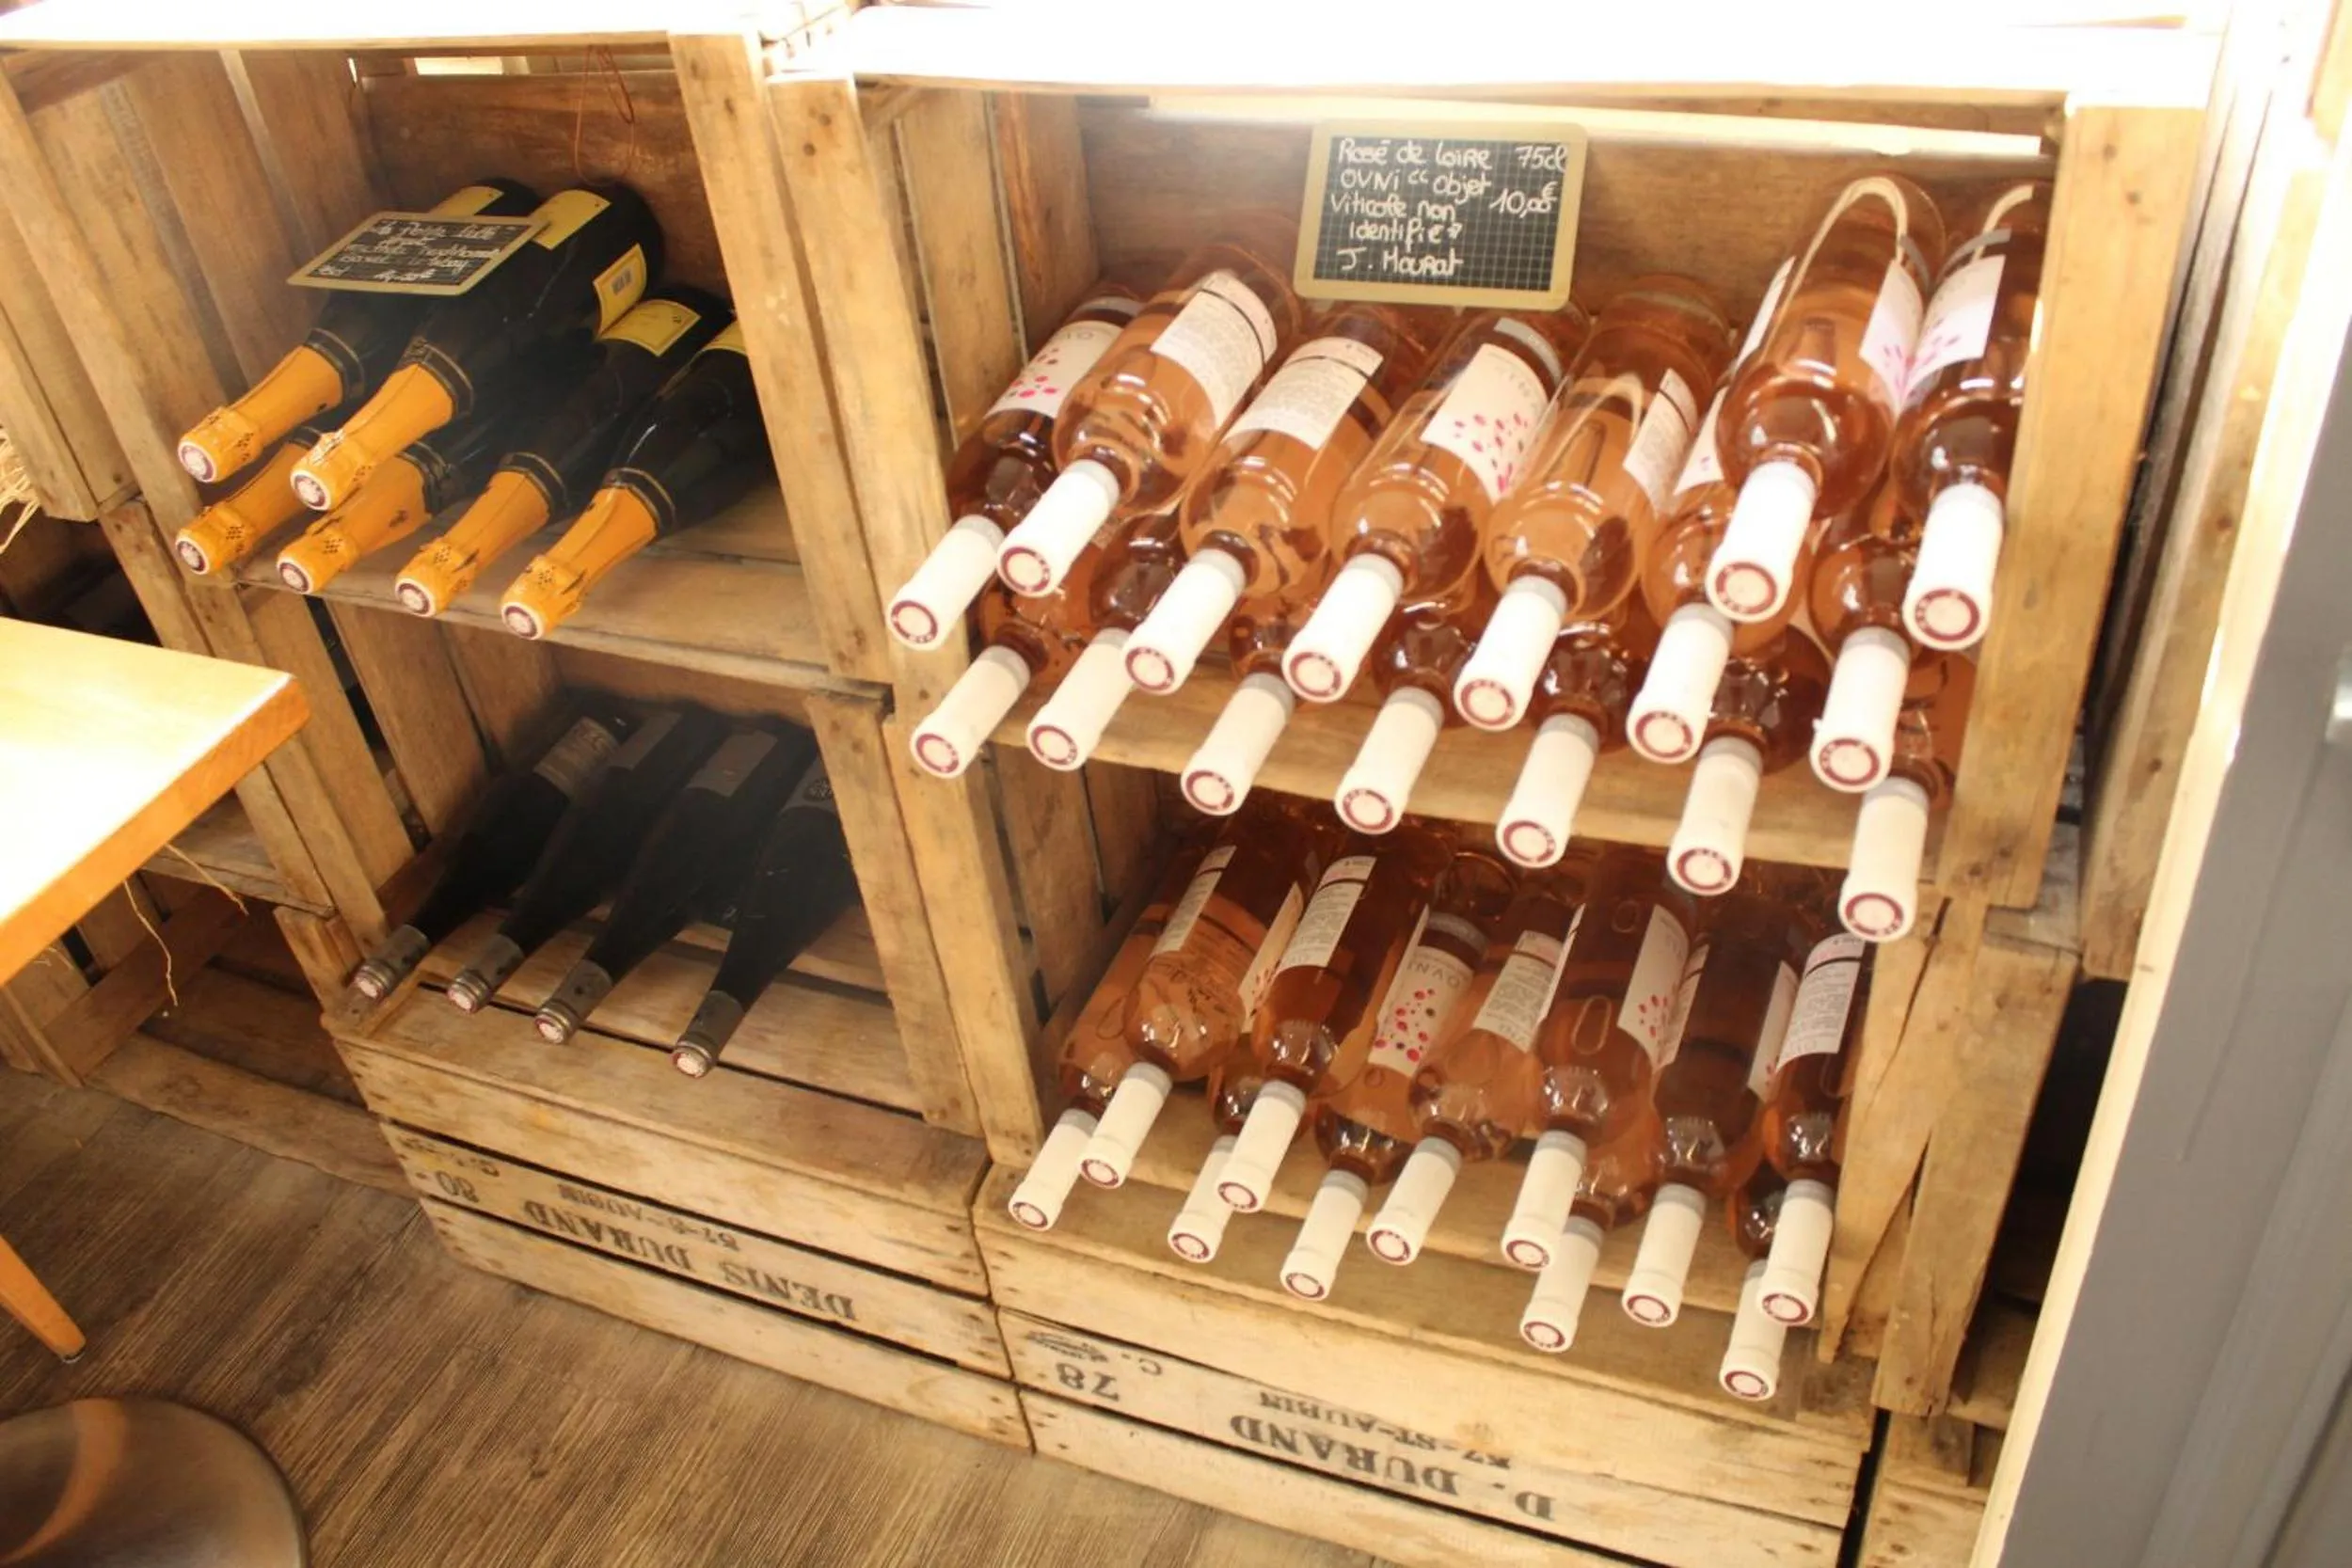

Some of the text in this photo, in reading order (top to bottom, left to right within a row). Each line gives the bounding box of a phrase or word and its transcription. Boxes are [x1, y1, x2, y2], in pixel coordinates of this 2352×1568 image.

[1338, 137, 1389, 166] Rosé
[1396, 139, 1427, 164] de
[524, 1200, 697, 1272] DURAND
[1056, 1363, 1120, 1402] 78
[1230, 1415, 1460, 1497] DURAND
